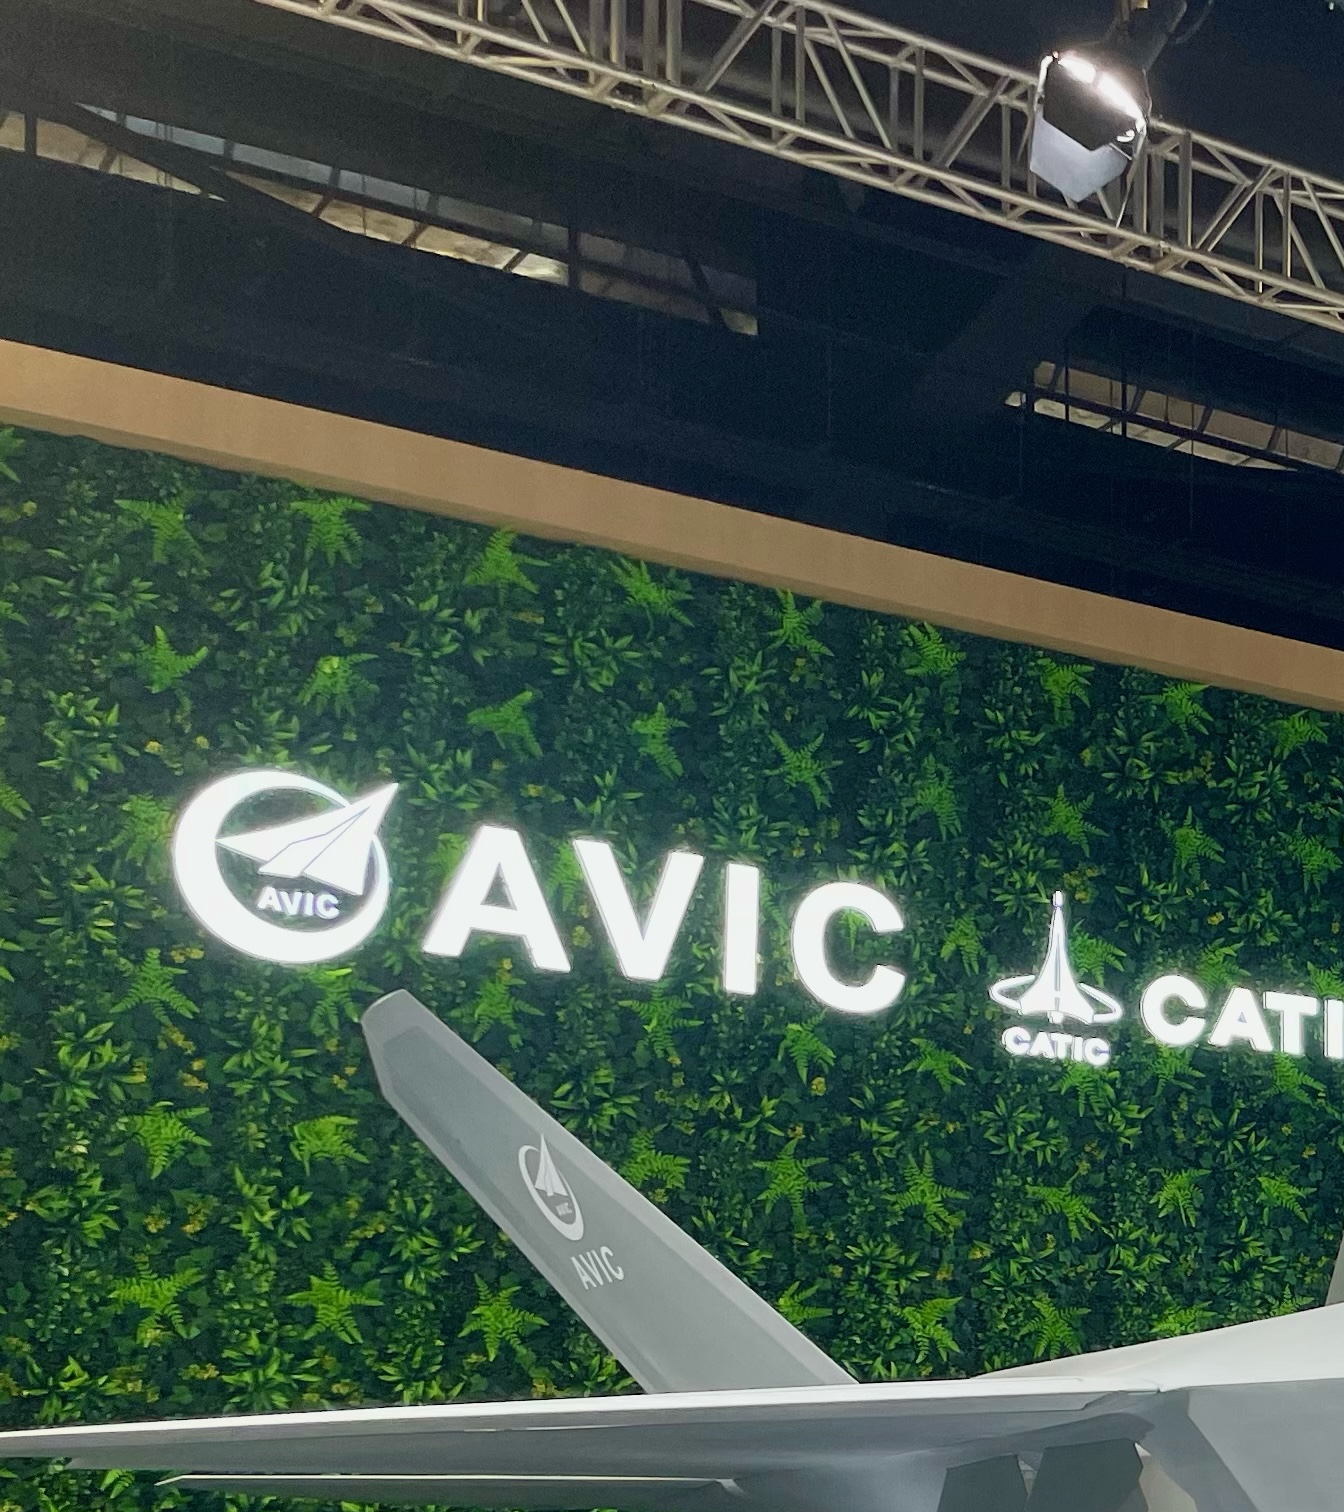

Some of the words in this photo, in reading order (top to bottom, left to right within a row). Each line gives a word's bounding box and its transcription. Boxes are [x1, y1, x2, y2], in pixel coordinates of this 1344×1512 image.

[257, 886, 341, 920] AVIC
[422, 825, 906, 1013] AVIC
[1002, 1026, 1111, 1066] CATIC
[571, 1246, 624, 1290] AVIC
